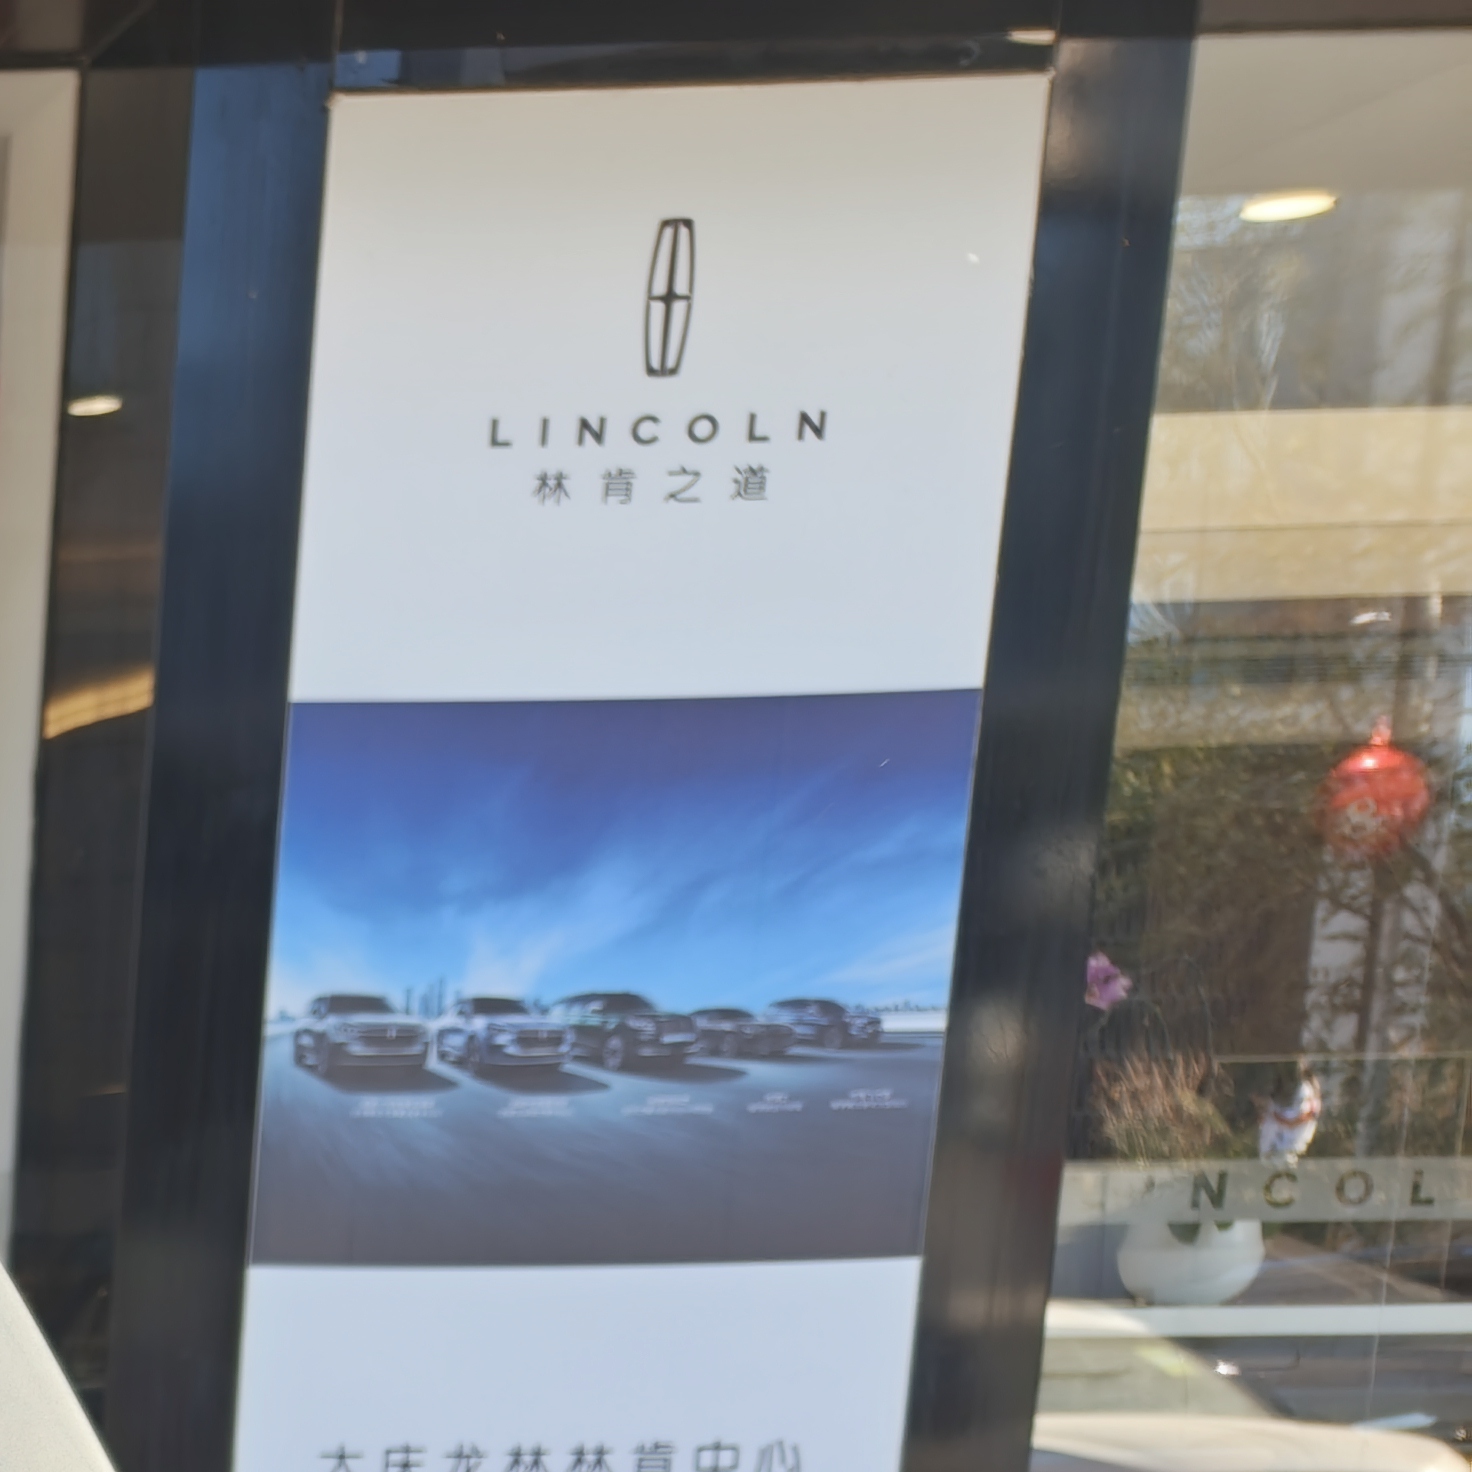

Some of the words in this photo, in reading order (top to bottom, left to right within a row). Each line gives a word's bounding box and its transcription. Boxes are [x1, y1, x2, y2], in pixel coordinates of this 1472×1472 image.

[487, 409, 829, 449] LINCOLN
[531, 463, 771, 506] 林肯之道
[1142, 1168, 1436, 1211] NCOL
